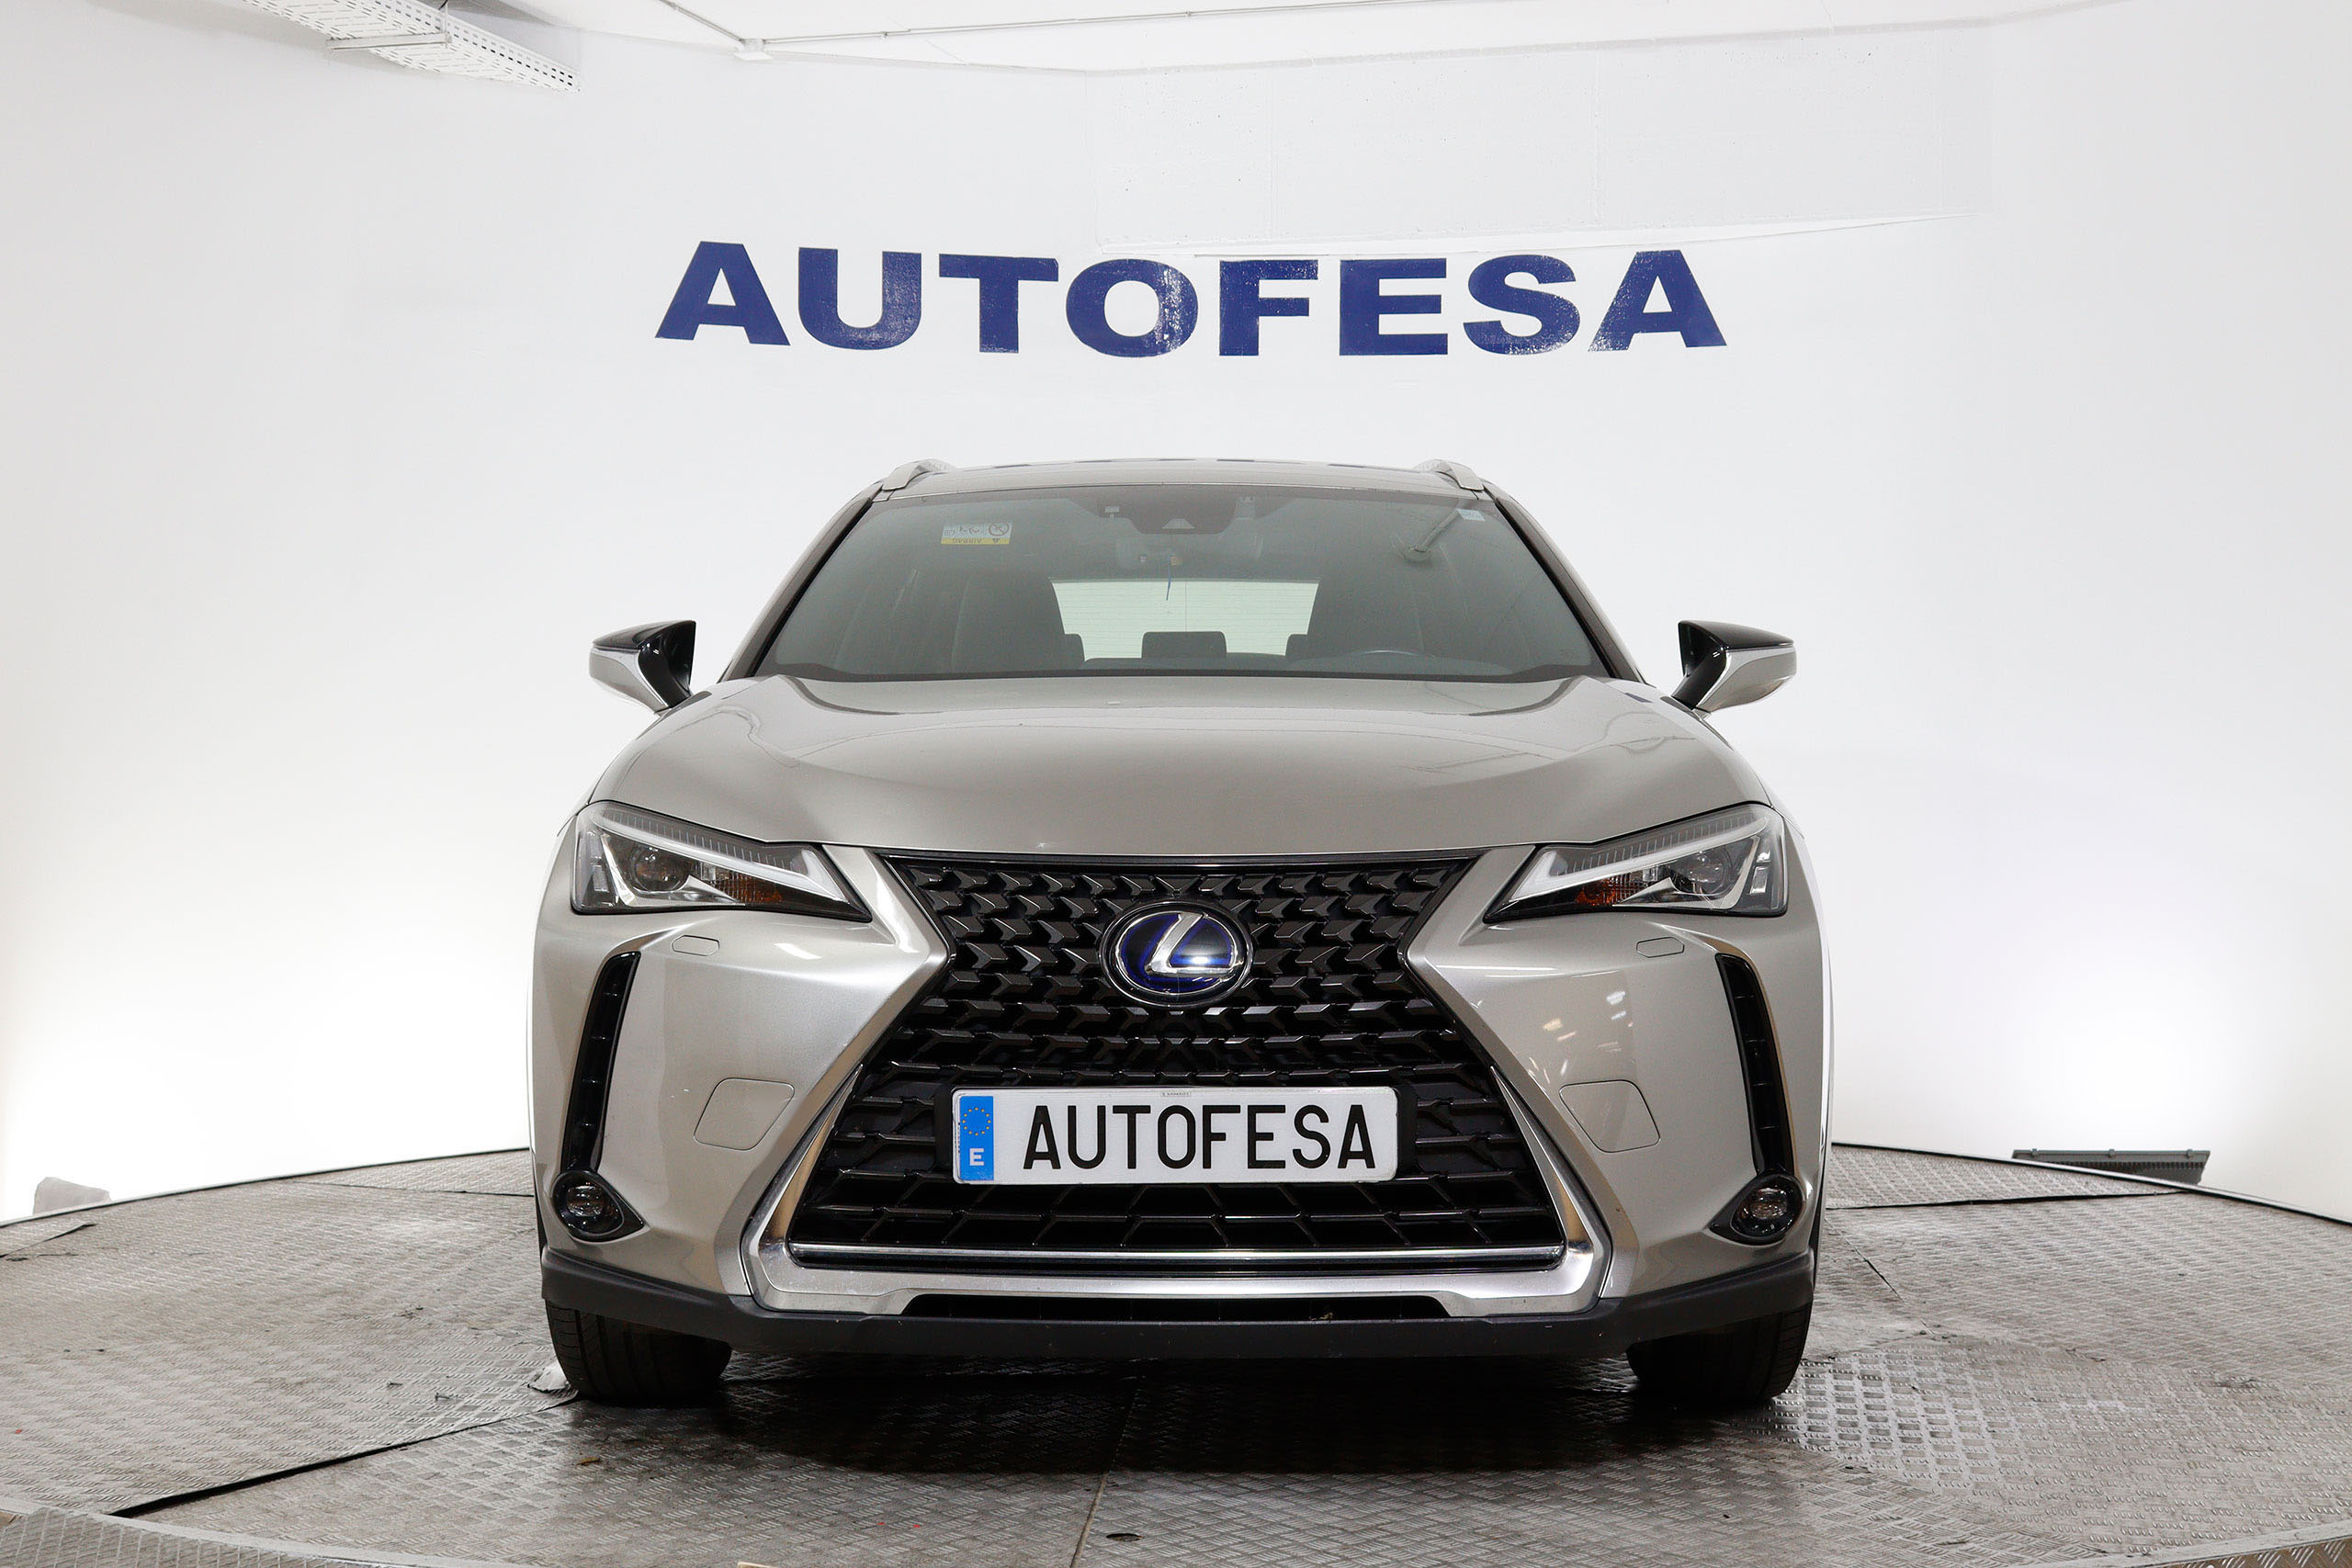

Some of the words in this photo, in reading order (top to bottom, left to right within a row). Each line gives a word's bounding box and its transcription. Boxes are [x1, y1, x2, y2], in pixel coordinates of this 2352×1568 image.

[655, 241, 1728, 358] AUTOFESA
[969, 1147, 984, 1166] E
[1023, 1104, 1375, 1169] AUTOFESA
